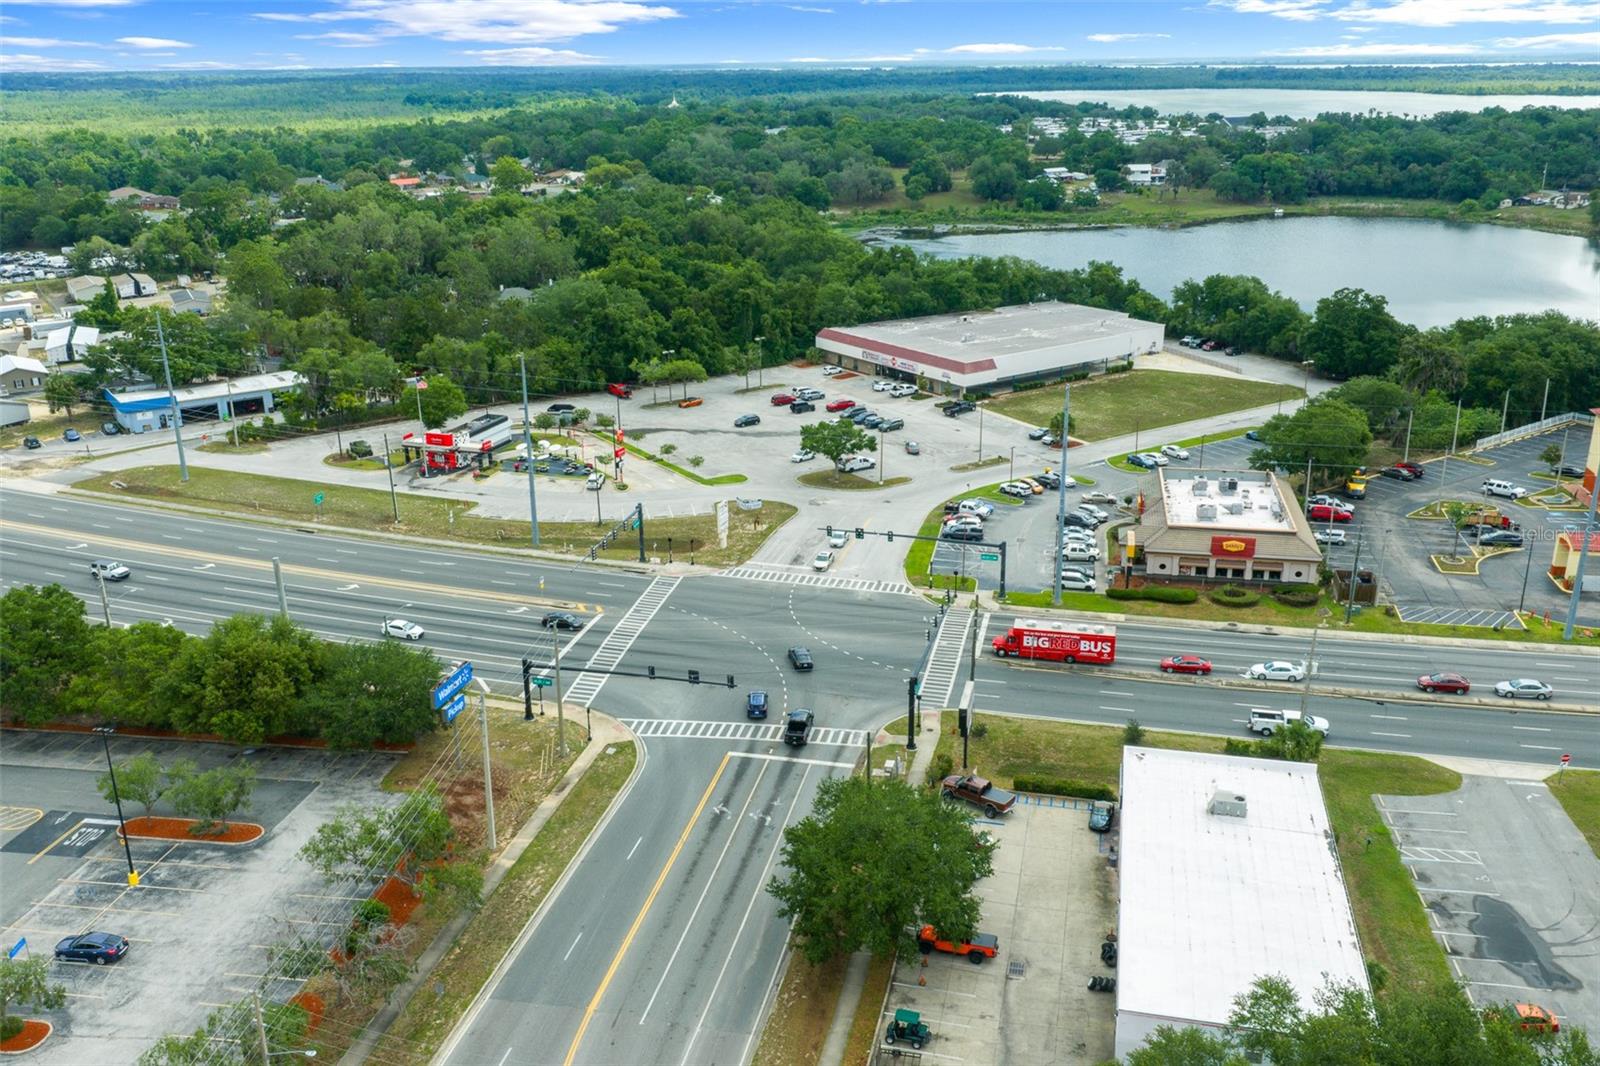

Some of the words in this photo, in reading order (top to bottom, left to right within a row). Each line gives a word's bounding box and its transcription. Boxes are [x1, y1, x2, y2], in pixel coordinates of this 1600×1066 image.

[438, 675, 463, 700] Walmart
[448, 701, 464, 719] Pickup
[63, 828, 105, 846] STOP
